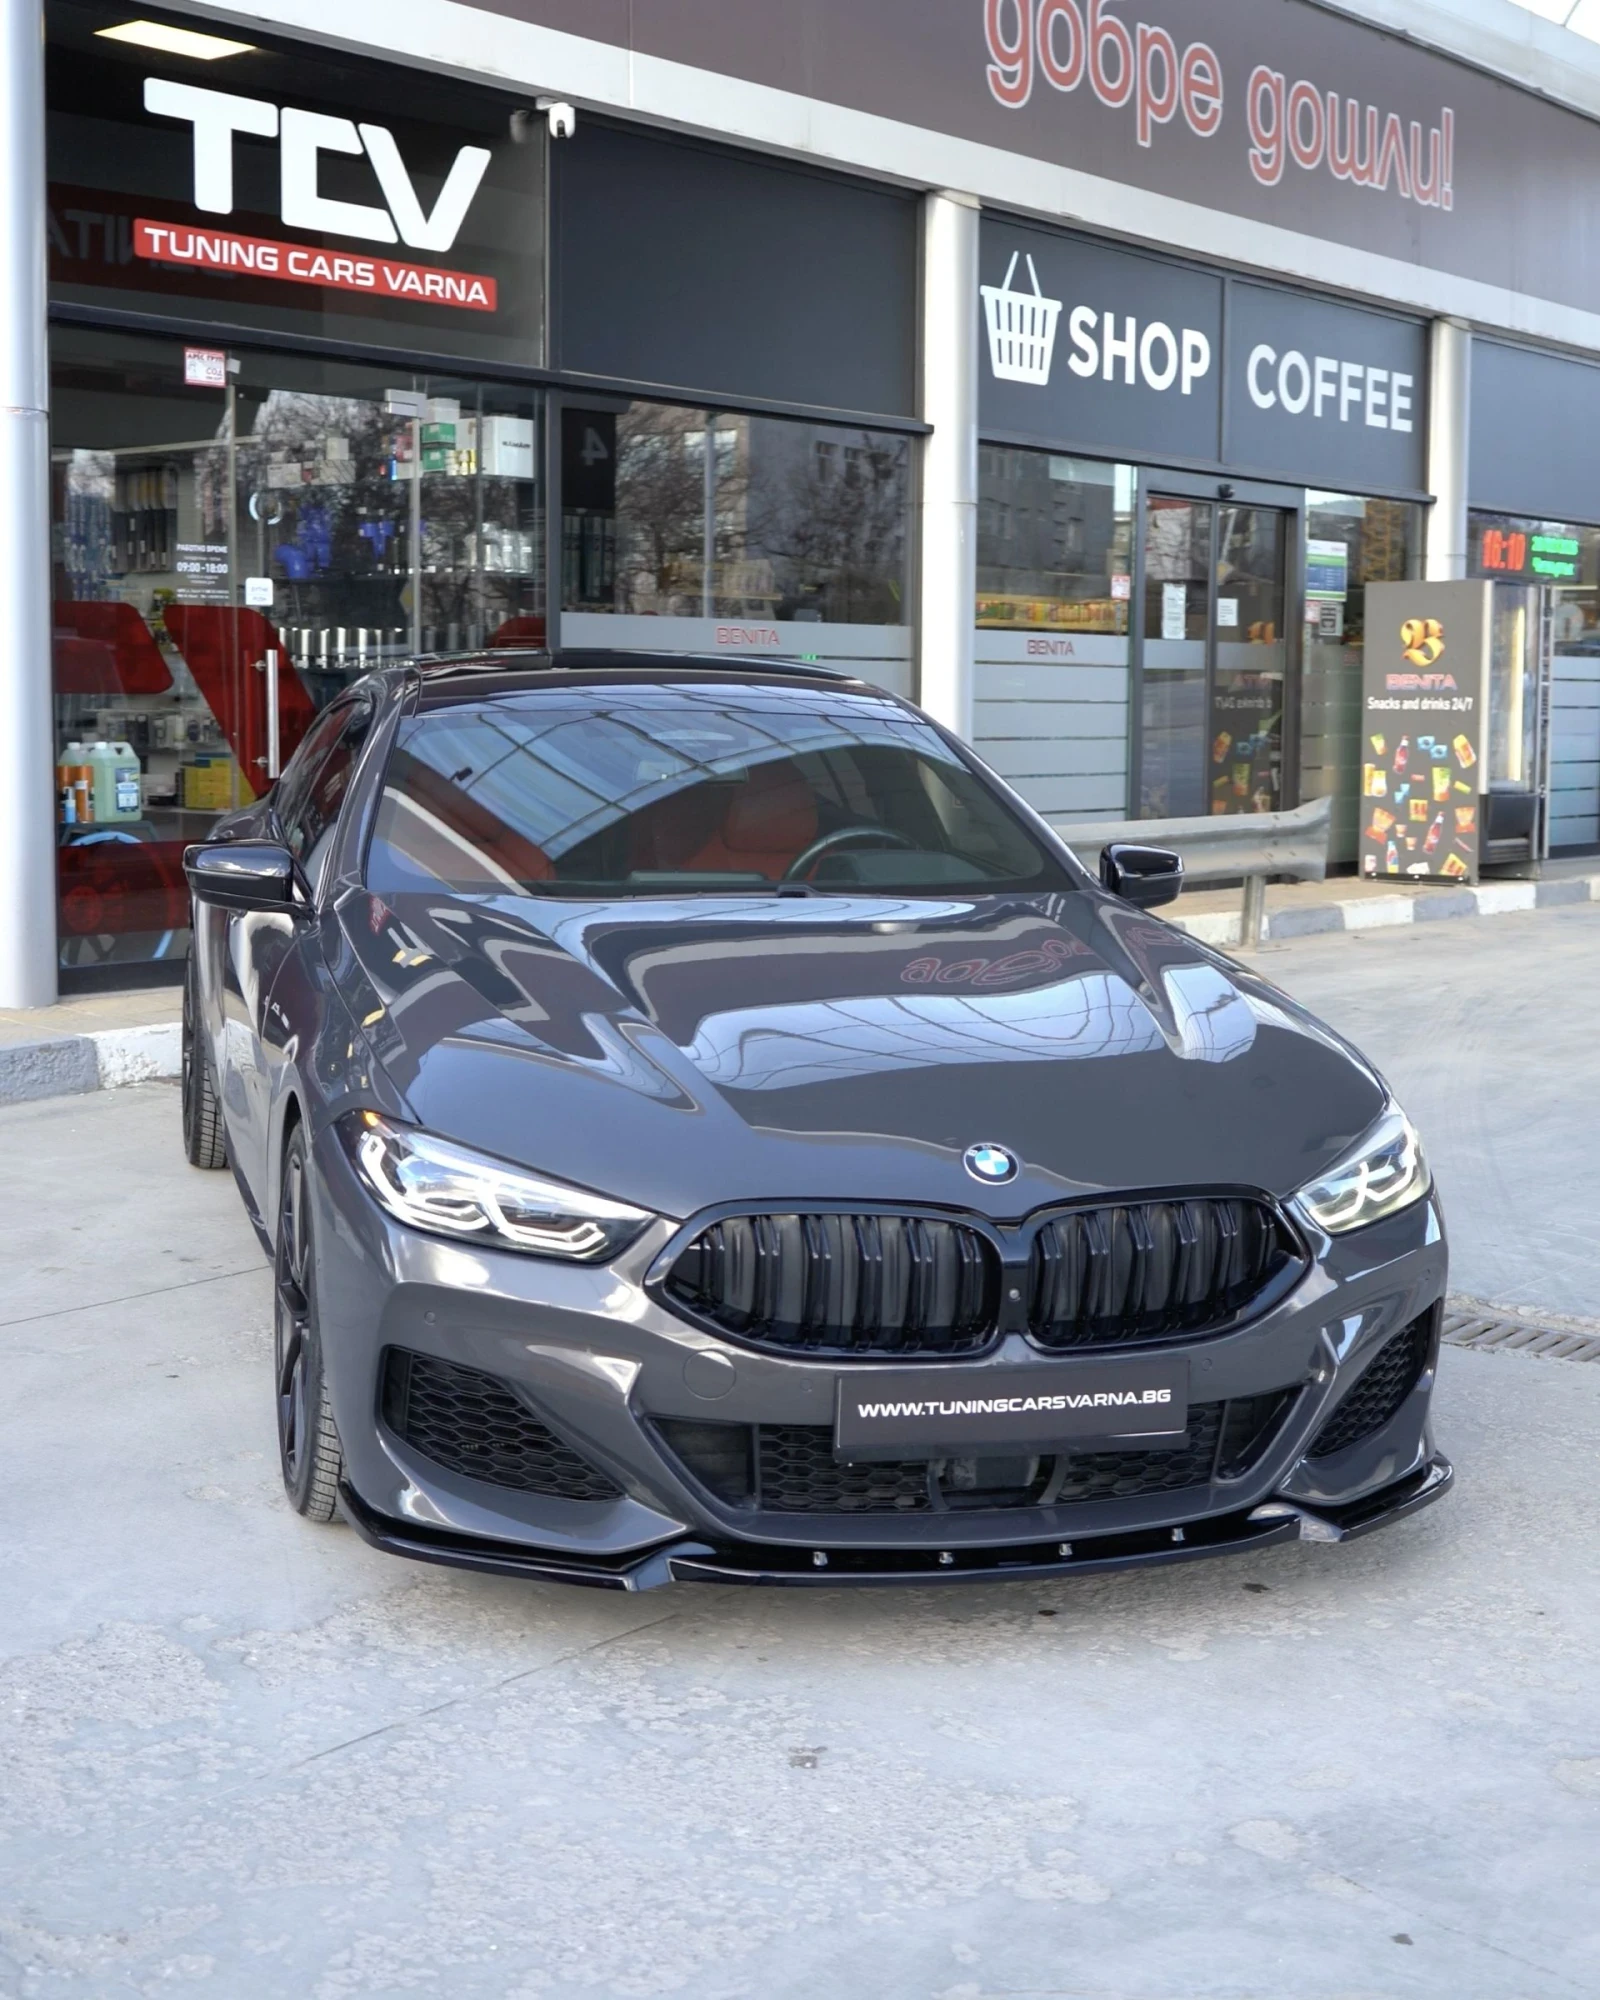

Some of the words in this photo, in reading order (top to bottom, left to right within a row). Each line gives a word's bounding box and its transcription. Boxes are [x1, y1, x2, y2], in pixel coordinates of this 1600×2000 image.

[144, 77, 491, 253] TCV
[1247, 65, 1455, 211] дошли!
[144, 227, 279, 272] TUNING
[287, 251, 375, 287] CARS
[382, 266, 489, 305] VARNA
[1067, 305, 1211, 395] SHOP
[1247, 343, 1414, 433] COFFEE
[716, 626, 780, 647] BENITA
[1027, 639, 1075, 656] BENITA
[1367, 696, 1401, 711] Snacks
[1402, 698, 1420, 711] and
[1420, 697, 1451, 711] drinks
[1451, 696, 1474, 712] 24/7
[1385, 673, 1459, 691] BENITA
[857, 1388, 1172, 1418] WWW.TUNINGCARSVARNA.BG
